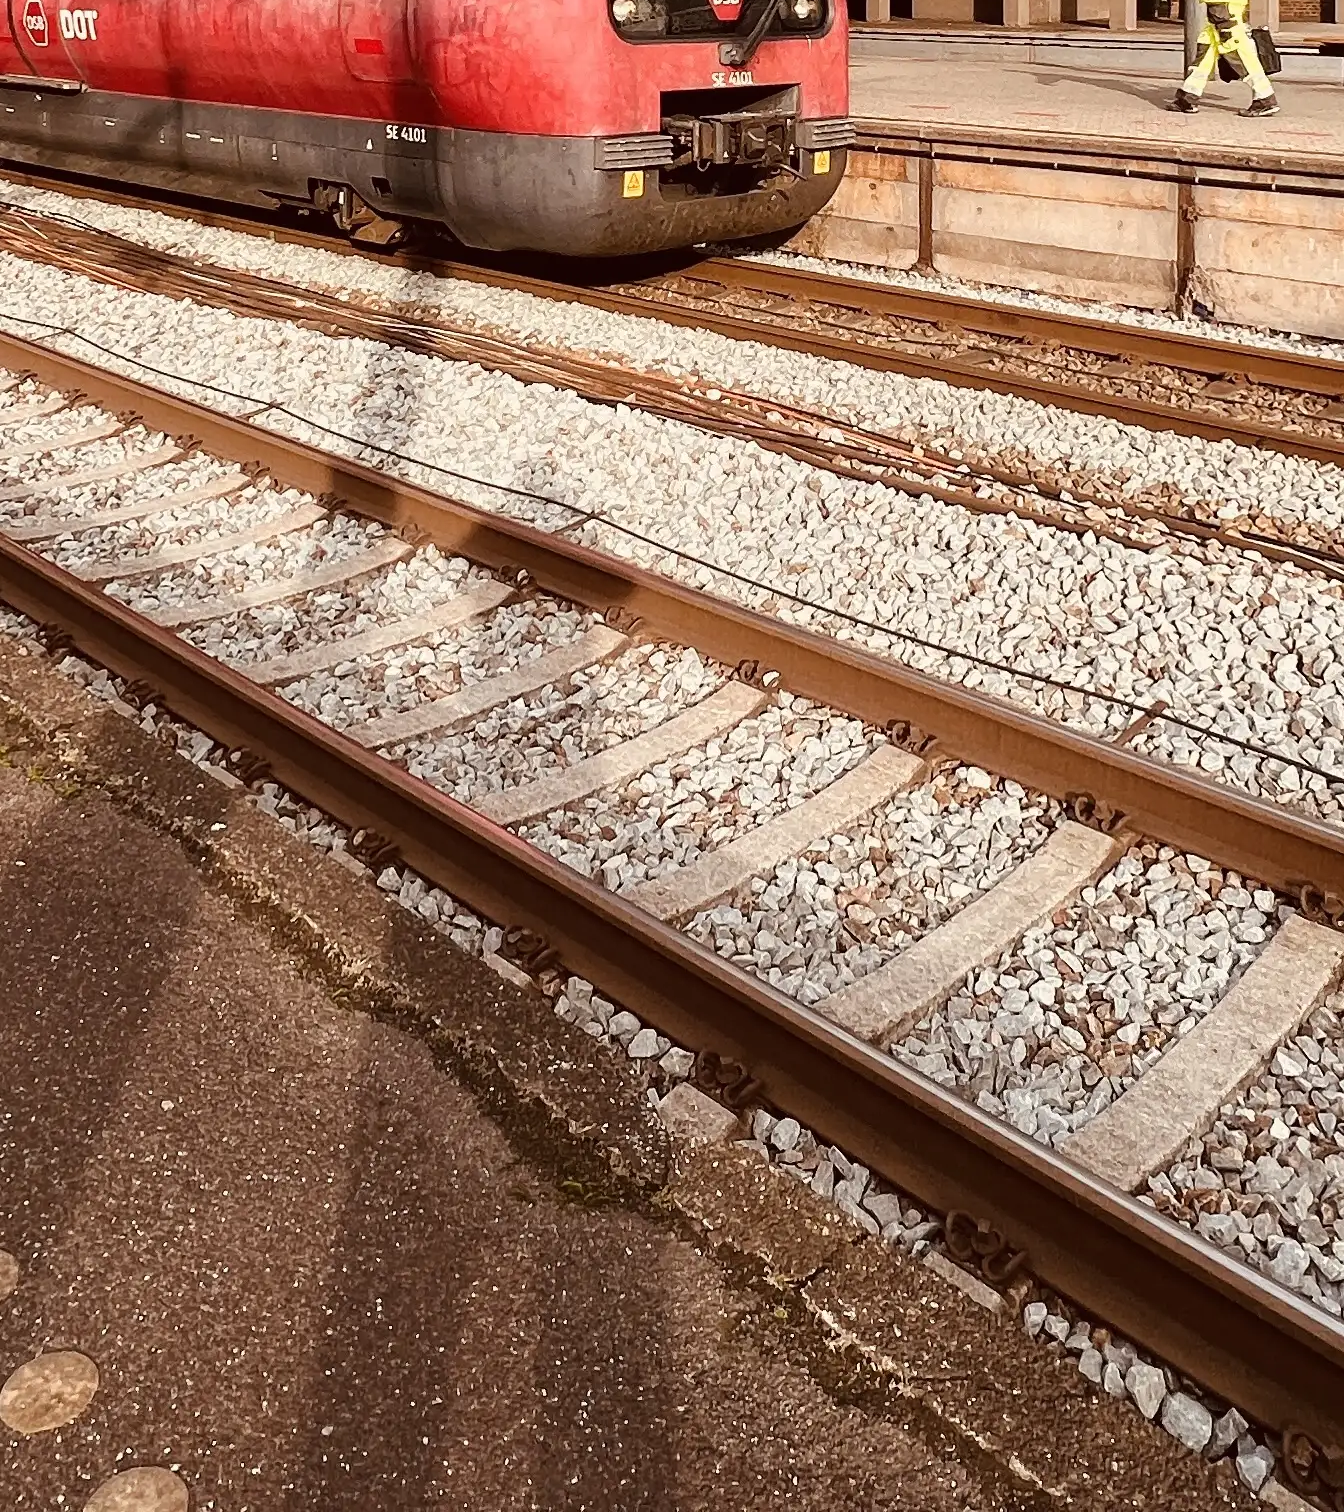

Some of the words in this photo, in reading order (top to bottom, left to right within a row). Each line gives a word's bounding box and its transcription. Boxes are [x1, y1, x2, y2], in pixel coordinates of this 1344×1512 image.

[26, 15, 45, 31] DSB
[59, 9, 98, 41] DOT
[711, 72, 726, 87] SE
[728, 71, 753, 86] 4101
[386, 124, 399, 140] SE
[400, 126, 427, 143] 4101
